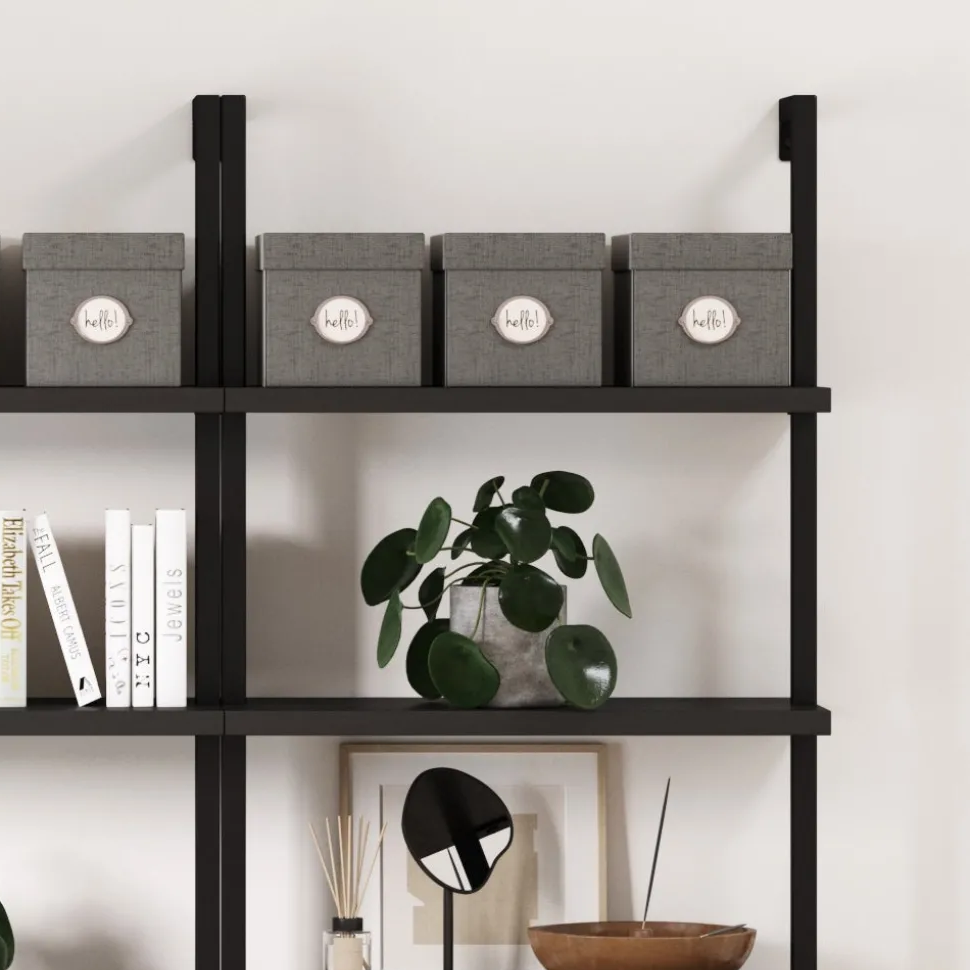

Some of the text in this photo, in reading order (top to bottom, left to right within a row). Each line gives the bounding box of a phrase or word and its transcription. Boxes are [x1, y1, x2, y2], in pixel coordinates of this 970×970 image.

[84, 309, 118, 330] hello!
[325, 309, 359, 330] hello!
[505, 309, 539, 330] hello!
[692, 309, 726, 330] hello!
[2, 517, 24, 578] Elizabeth
[34, 533, 56, 574] FALL
[1, 580, 23, 616] Takes
[162, 568, 182, 642] Jewels
[0, 617, 23, 642] Off
[50, 584, 81, 660] ALBERT CAMUS
[136, 631, 150, 688] NYC
